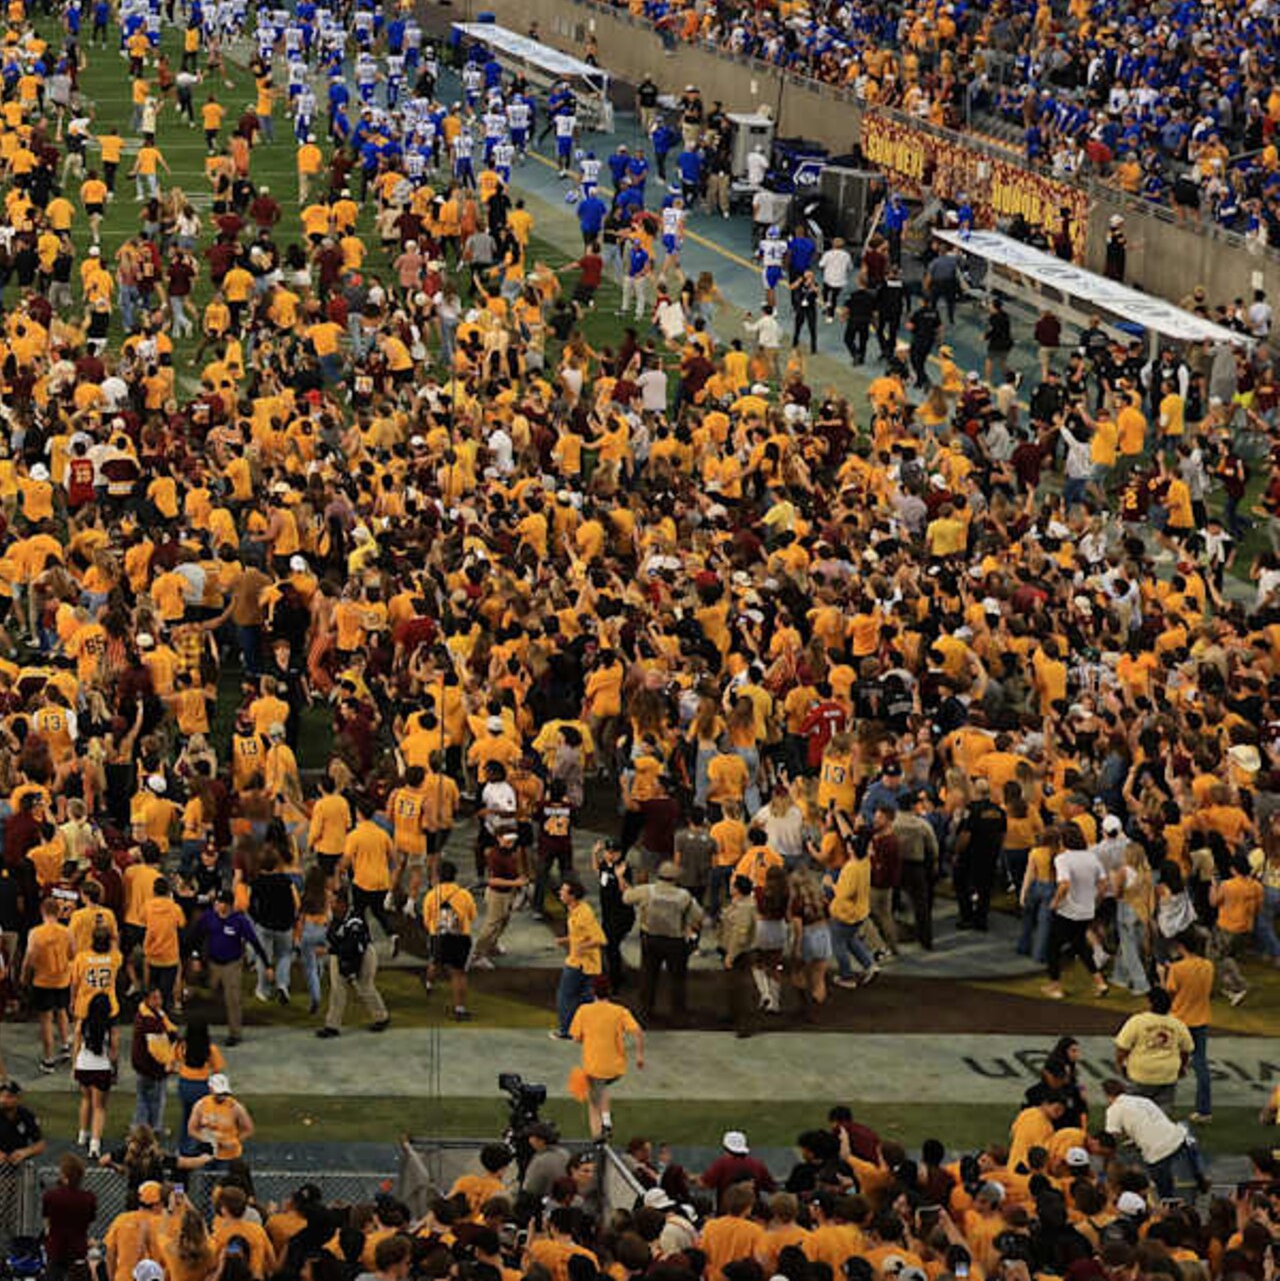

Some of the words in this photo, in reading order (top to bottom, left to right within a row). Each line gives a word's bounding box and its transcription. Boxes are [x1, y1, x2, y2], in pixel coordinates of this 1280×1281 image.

[43, 715, 61, 732] 13
[825, 766, 845, 784] 13
[86, 968, 111, 988] 42
